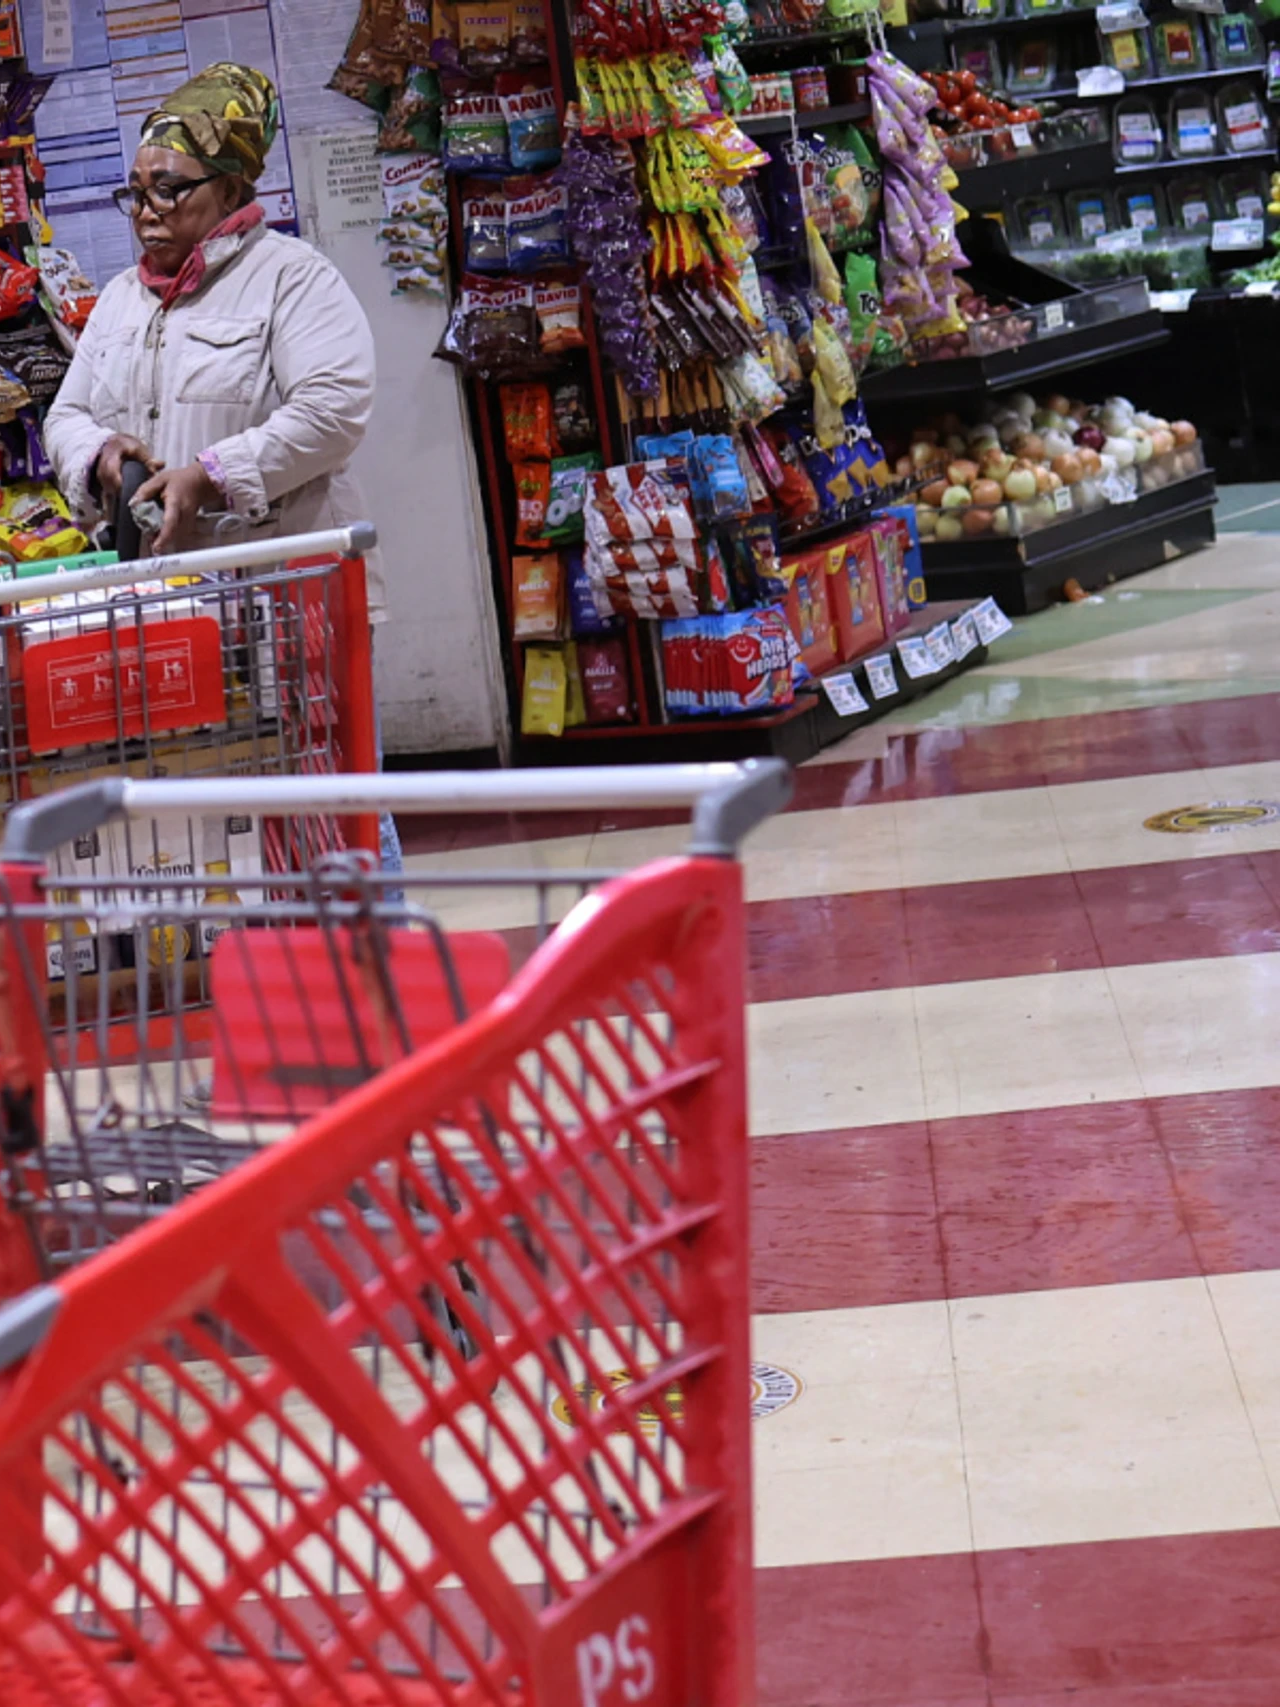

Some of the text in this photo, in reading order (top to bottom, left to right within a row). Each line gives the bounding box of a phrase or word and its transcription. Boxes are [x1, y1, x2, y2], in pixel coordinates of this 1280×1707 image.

[469, 202, 505, 217] DAV
[536, 287, 579, 304] DAVID
[760, 639, 785, 658] AIR
[746, 653, 787, 680] HEADS
